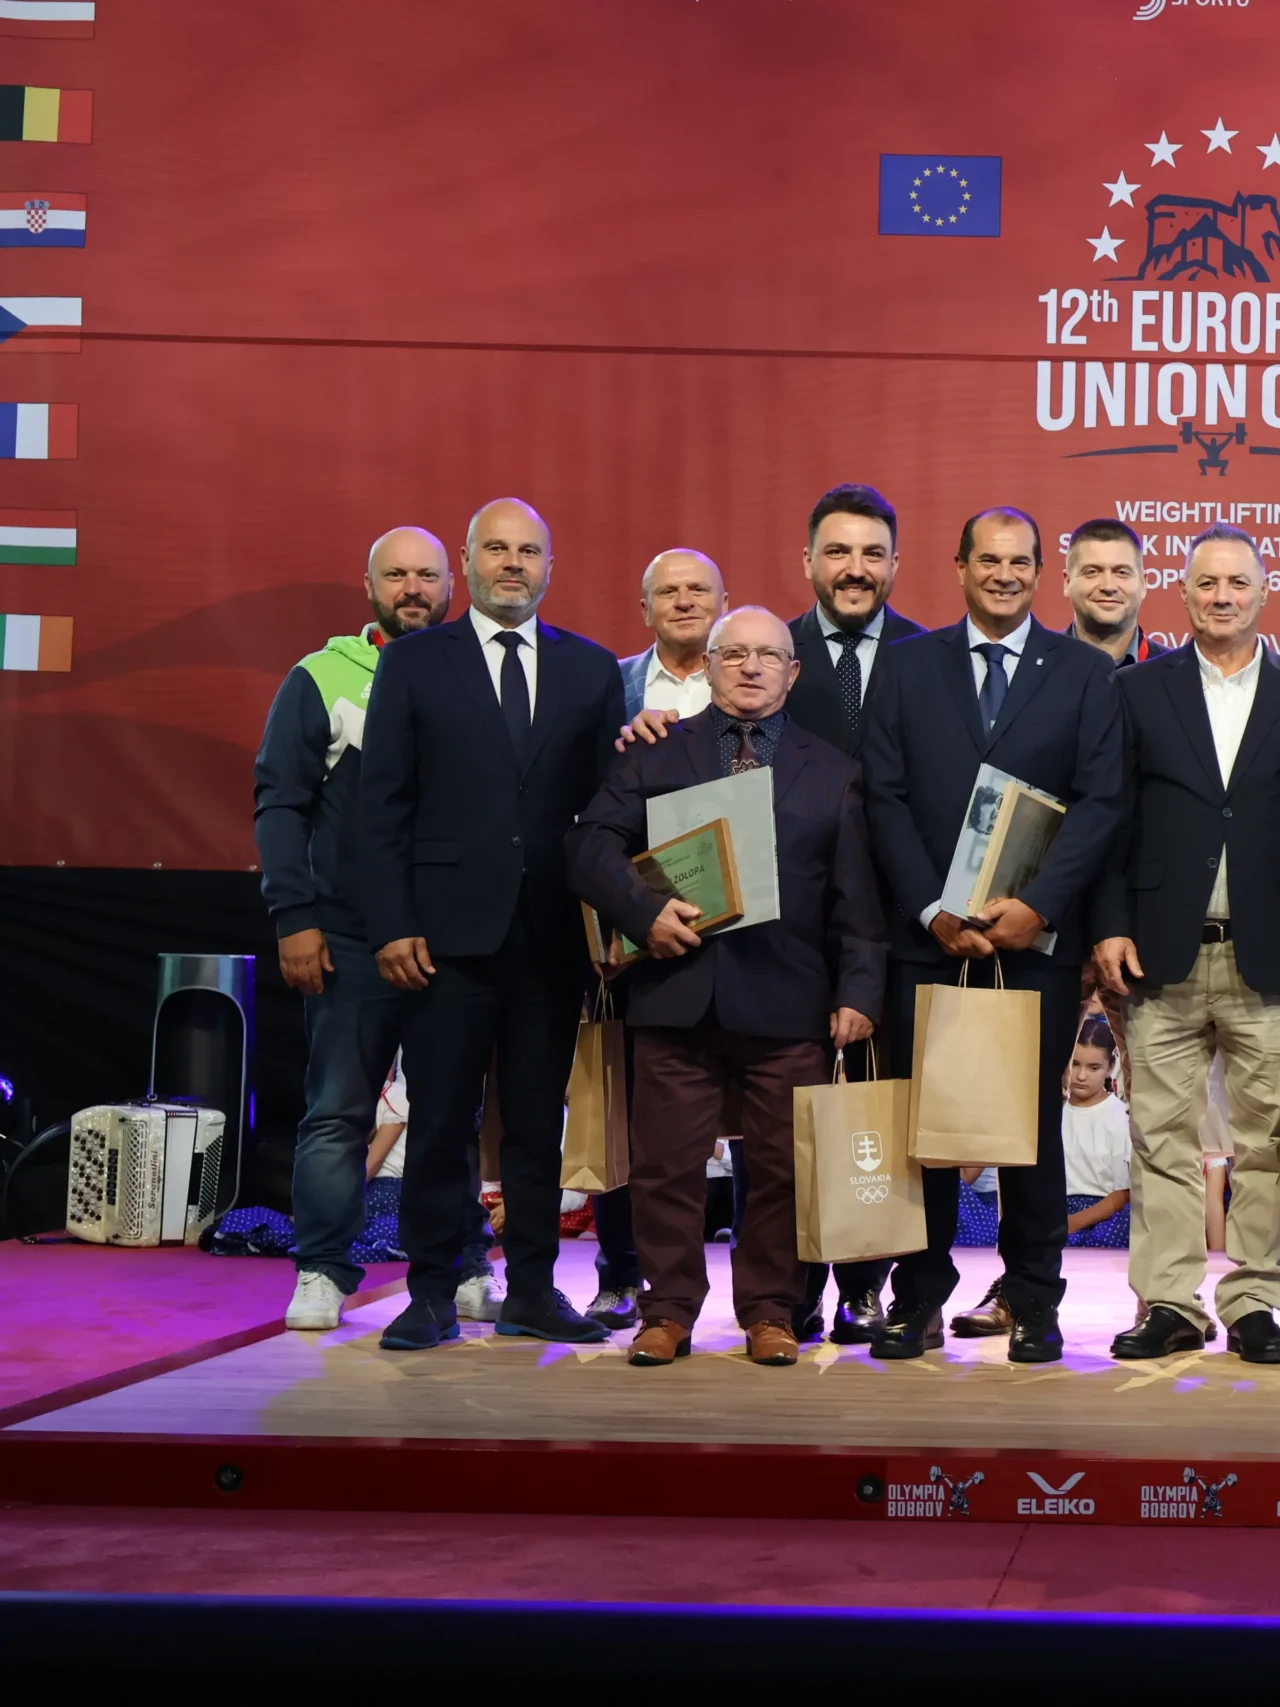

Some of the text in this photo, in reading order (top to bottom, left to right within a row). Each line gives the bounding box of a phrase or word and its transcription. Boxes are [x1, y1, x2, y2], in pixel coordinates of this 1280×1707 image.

[1038, 288, 1118, 345] 12th
[1036, 361, 1247, 431] UNION
[1146, 568, 1186, 589] OP
[849, 1174, 892, 1185] SLOVAKIA
[888, 1485, 945, 1501] OLYMPIA
[1141, 1486, 1198, 1502] OLYMPIA
[888, 1501, 943, 1518] BOBROV
[1017, 1498, 1096, 1515] ELEIKO
[1141, 1502, 1196, 1519] BOBROV
